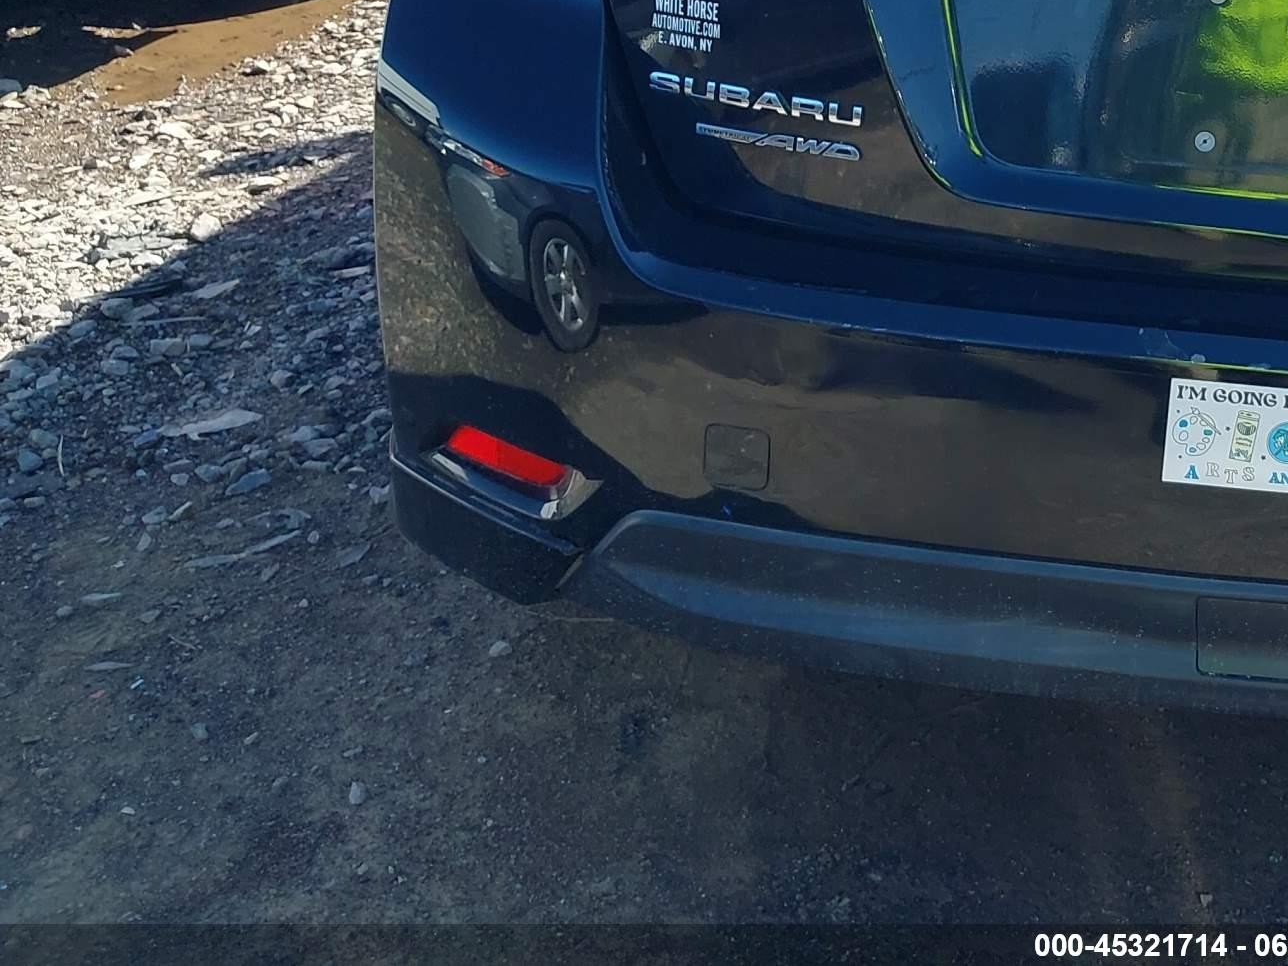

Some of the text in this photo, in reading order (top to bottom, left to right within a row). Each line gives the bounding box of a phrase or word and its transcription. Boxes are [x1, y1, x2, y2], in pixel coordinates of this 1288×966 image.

[651, 13, 721, 39] AUTOMOTIVE.COM
[658, 32, 713, 53] E. AVON, NY
[648, 70, 863, 127] SUBARU
[755, 134, 860, 161] AWD
[1176, 384, 1207, 402] I'M
[1213, 388, 1278, 408] GOING
[1184, 461, 1256, 484] ARTS
